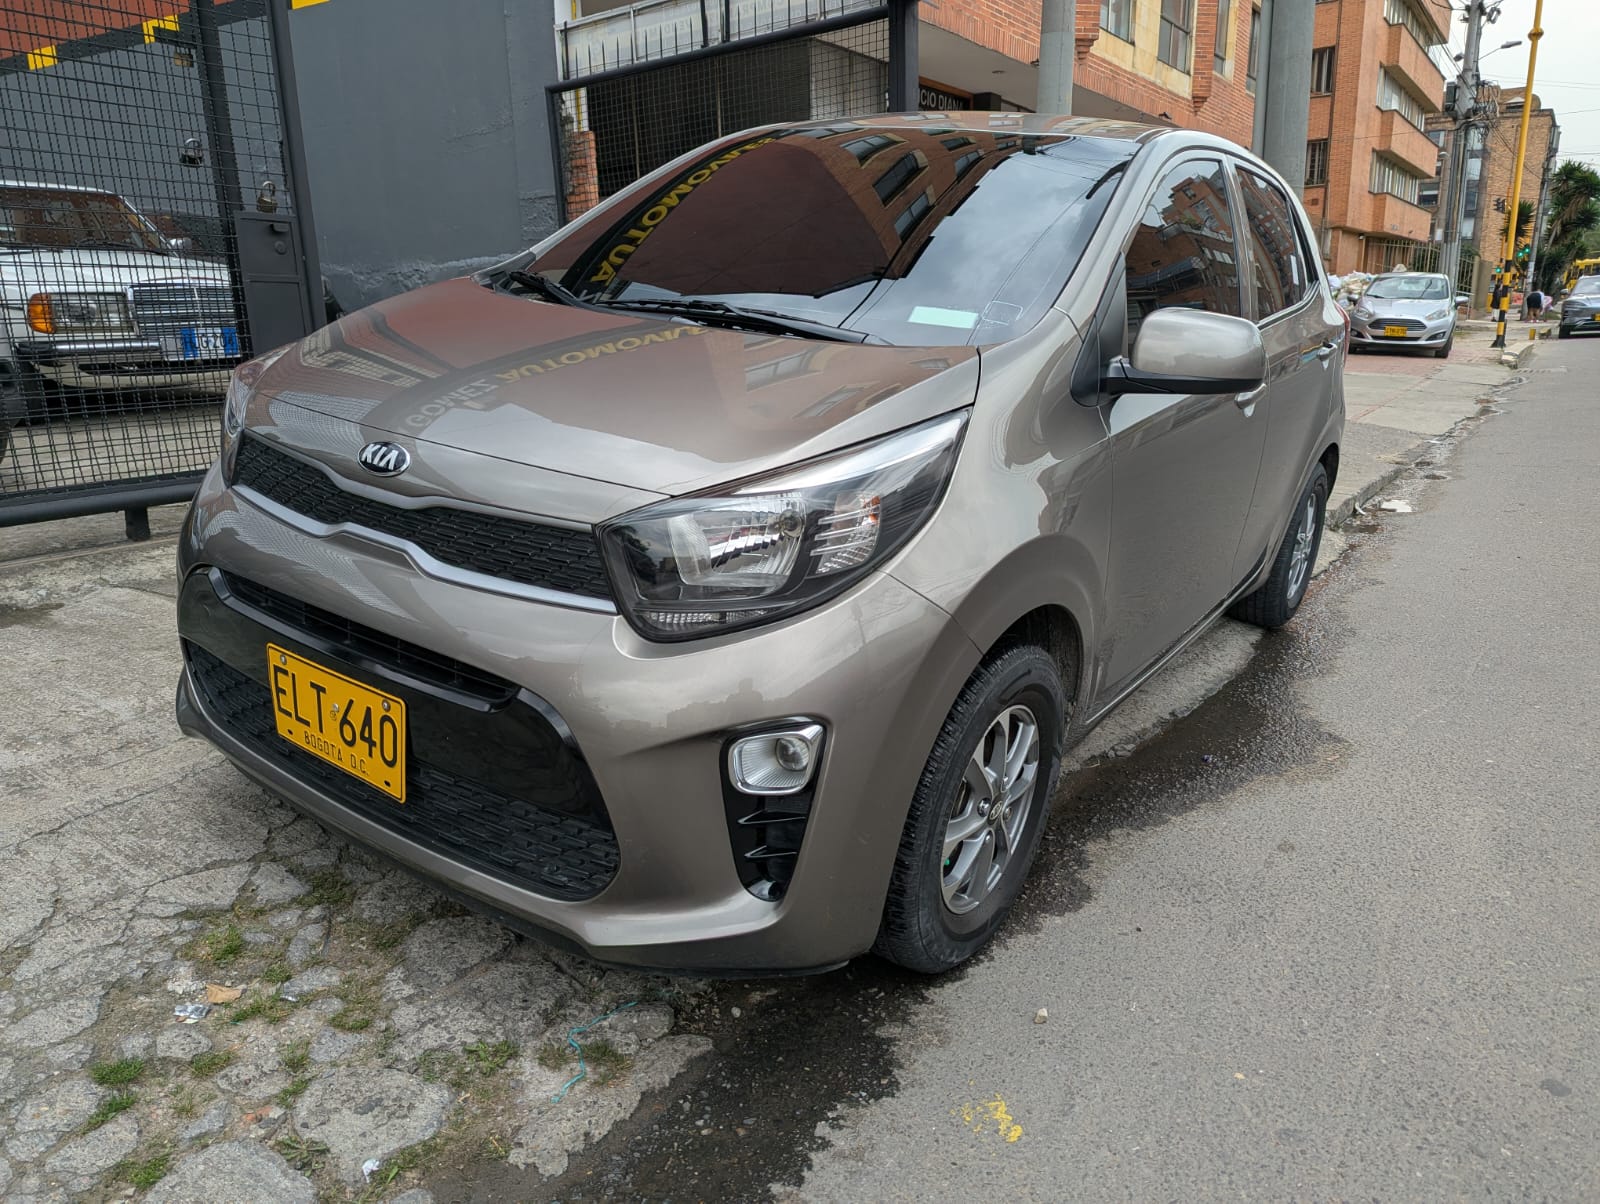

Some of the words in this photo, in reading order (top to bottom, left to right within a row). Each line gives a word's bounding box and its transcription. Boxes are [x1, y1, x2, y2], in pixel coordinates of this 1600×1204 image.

[361, 443, 399, 471] KIA
[273, 664, 327, 734] ELT
[339, 698, 398, 768] 640
[304, 730, 343, 763] BOGOTA
